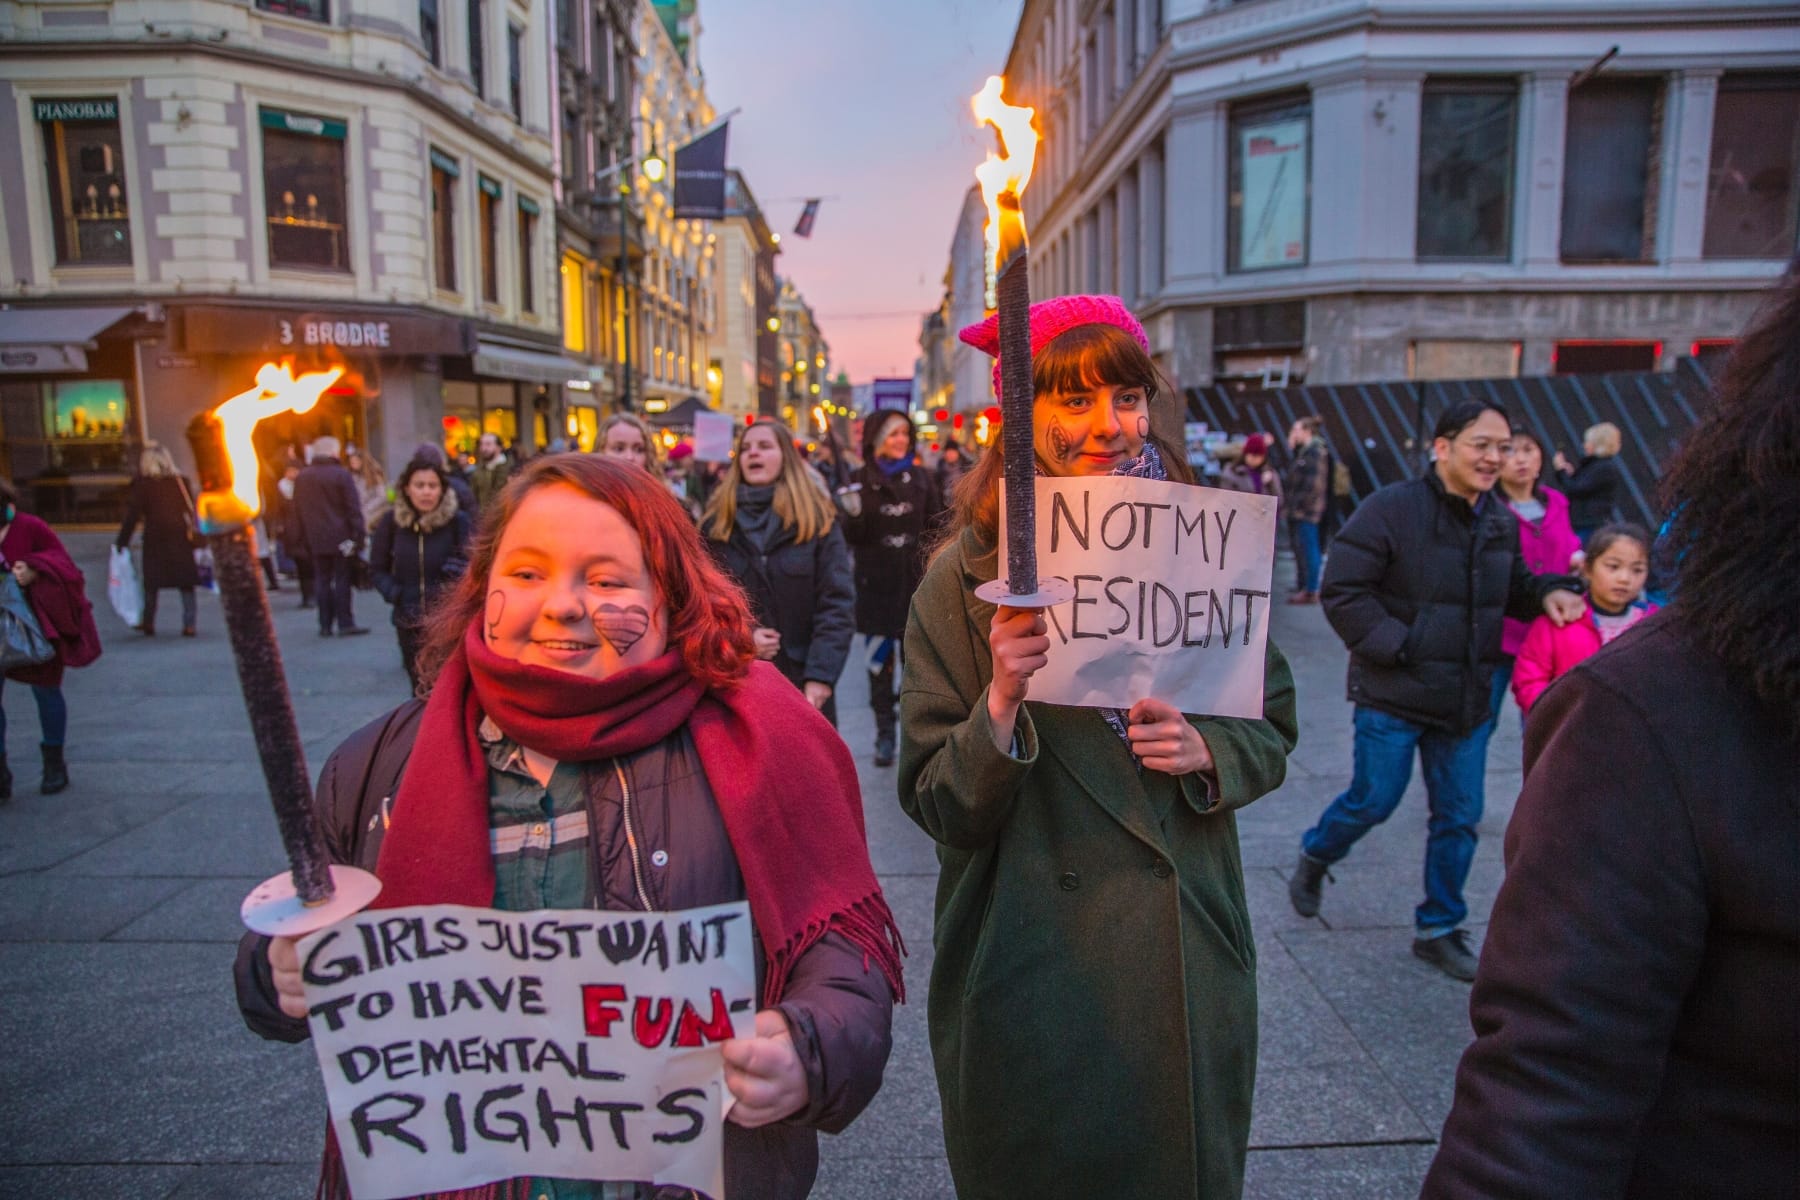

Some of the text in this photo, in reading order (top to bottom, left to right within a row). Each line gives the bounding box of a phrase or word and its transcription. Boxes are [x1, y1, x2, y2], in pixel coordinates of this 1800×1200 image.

[37, 101, 116, 120] PIANOBAR
[279, 321, 390, 347] 3 BRØDRE
[1050, 490, 1237, 570] NOT MY
[302, 912, 746, 984] GIRLS JUST WANT
[309, 989, 393, 1032] TO
[408, 976, 549, 1019] HAVE
[337, 1036, 627, 1083] DEMENTAL
[350, 1085, 707, 1157] RIGHTS
